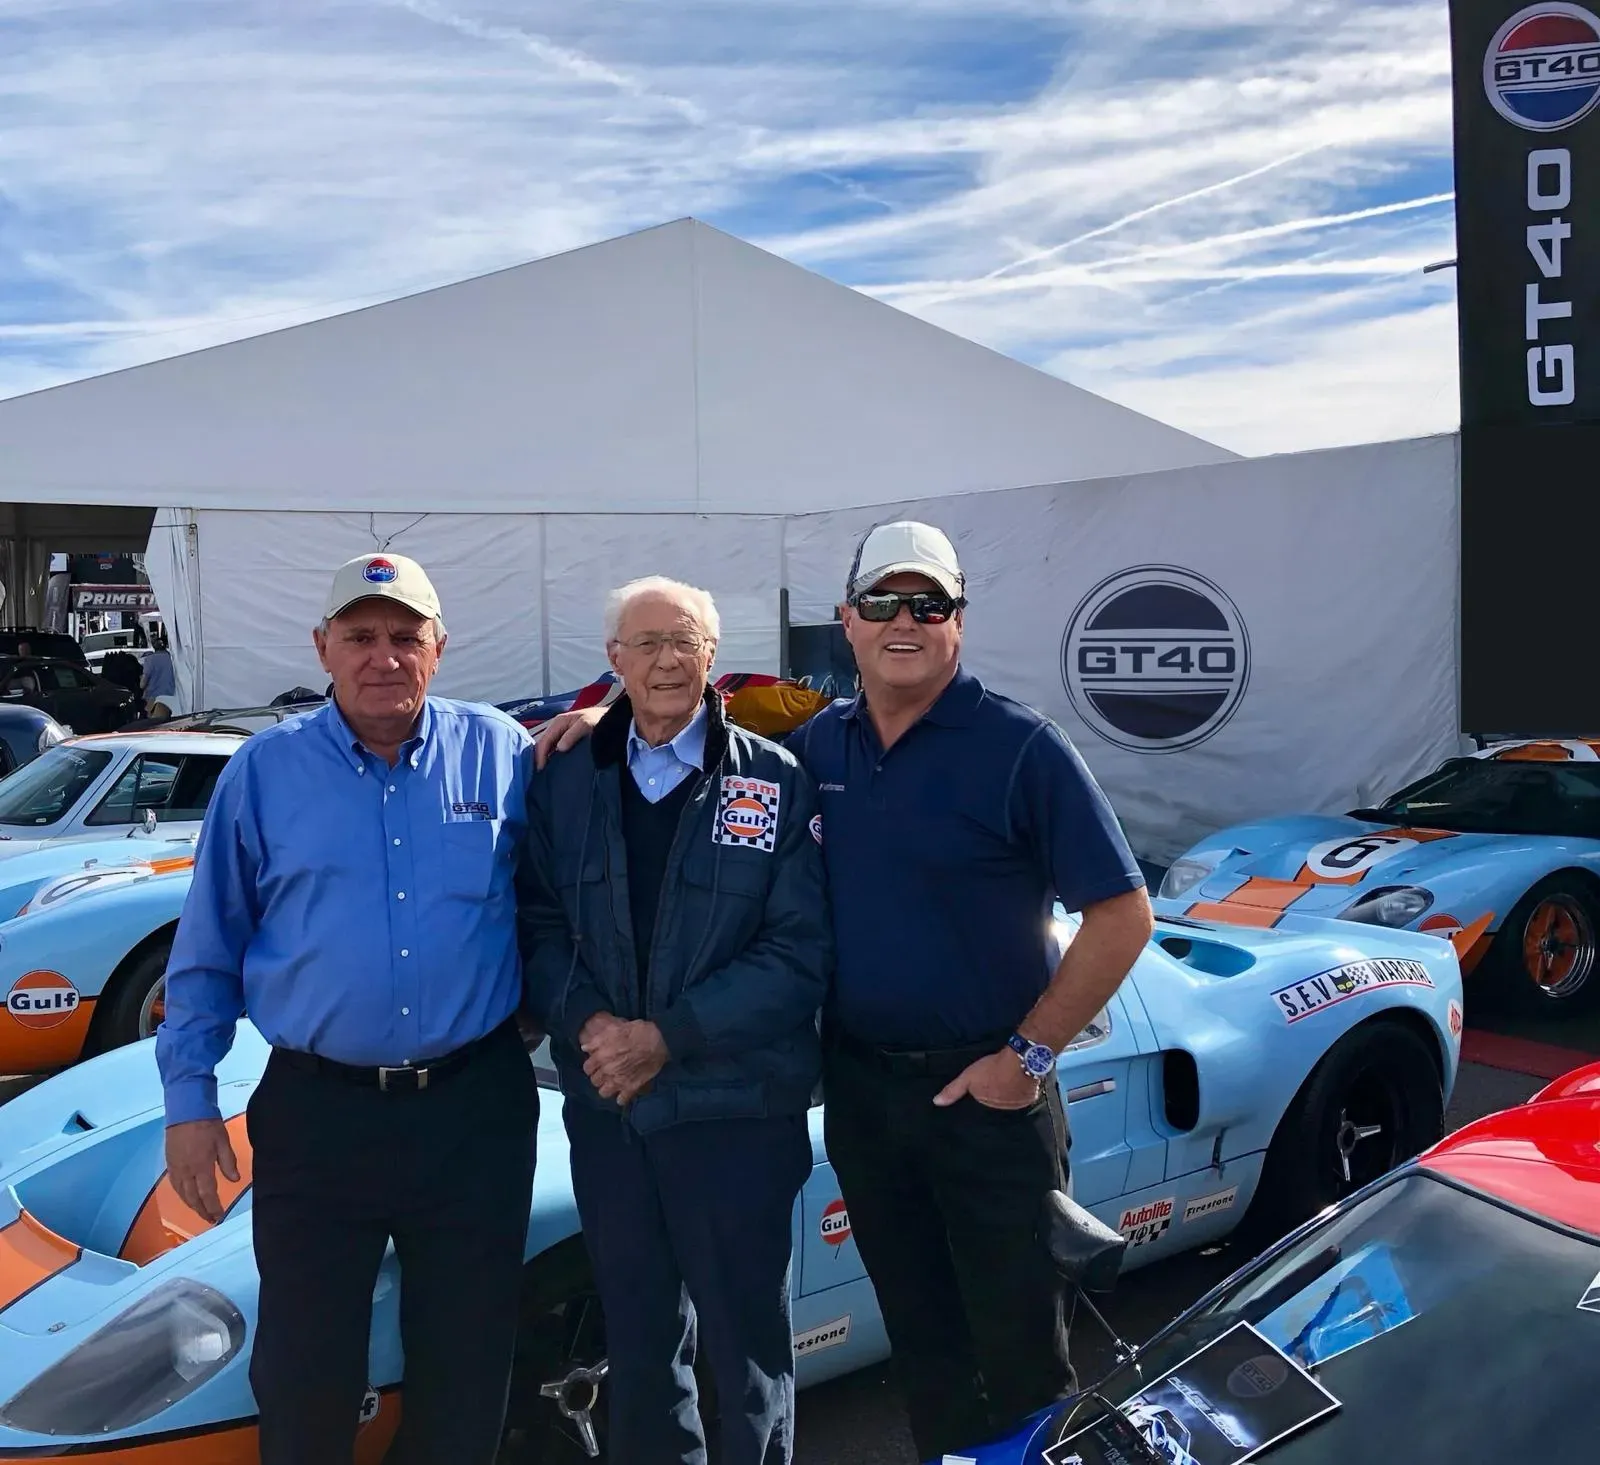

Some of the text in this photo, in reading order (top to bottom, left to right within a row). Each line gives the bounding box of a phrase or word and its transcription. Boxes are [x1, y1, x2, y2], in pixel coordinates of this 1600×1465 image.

[1495, 53, 1600, 81] GT40
[1526, 148, 1575, 406] GT40
[1078, 646, 1236, 674] GT40
[724, 779, 777, 796] team
[452, 804, 489, 812] GT40
[724, 810, 770, 828] Gulf
[1321, 838, 1401, 869] 6
[1365, 960, 1432, 984] MARCHAL
[10, 992, 77, 1010] Gulf
[1120, 1201, 1172, 1230] Autolite
[1186, 1194, 1235, 1218] Firestone
